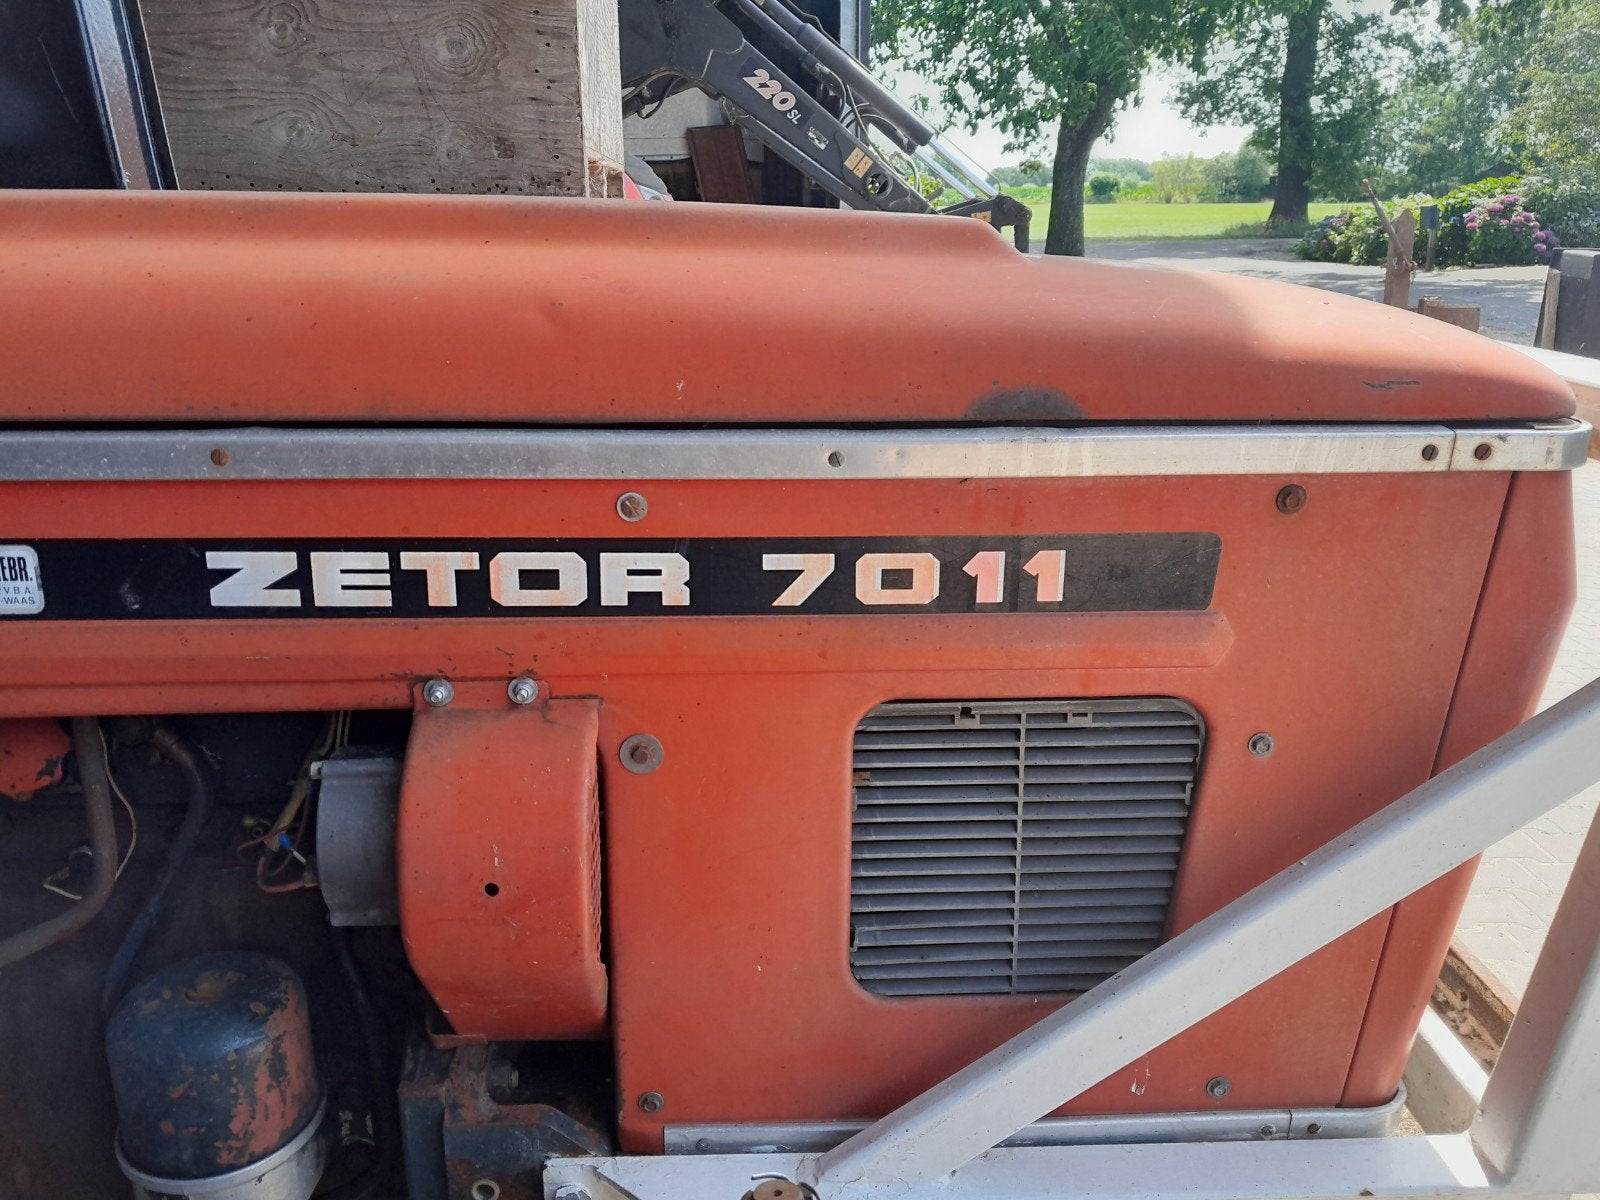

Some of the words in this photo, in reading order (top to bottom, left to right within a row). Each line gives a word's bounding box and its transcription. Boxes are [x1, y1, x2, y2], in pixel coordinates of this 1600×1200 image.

[742, 68, 797, 112] 220
[786, 109, 802, 125] SL
[0, 556, 33, 581] EBR.
[205, 551, 691, 607] ZETOR
[762, 549, 1067, 607] 7011
